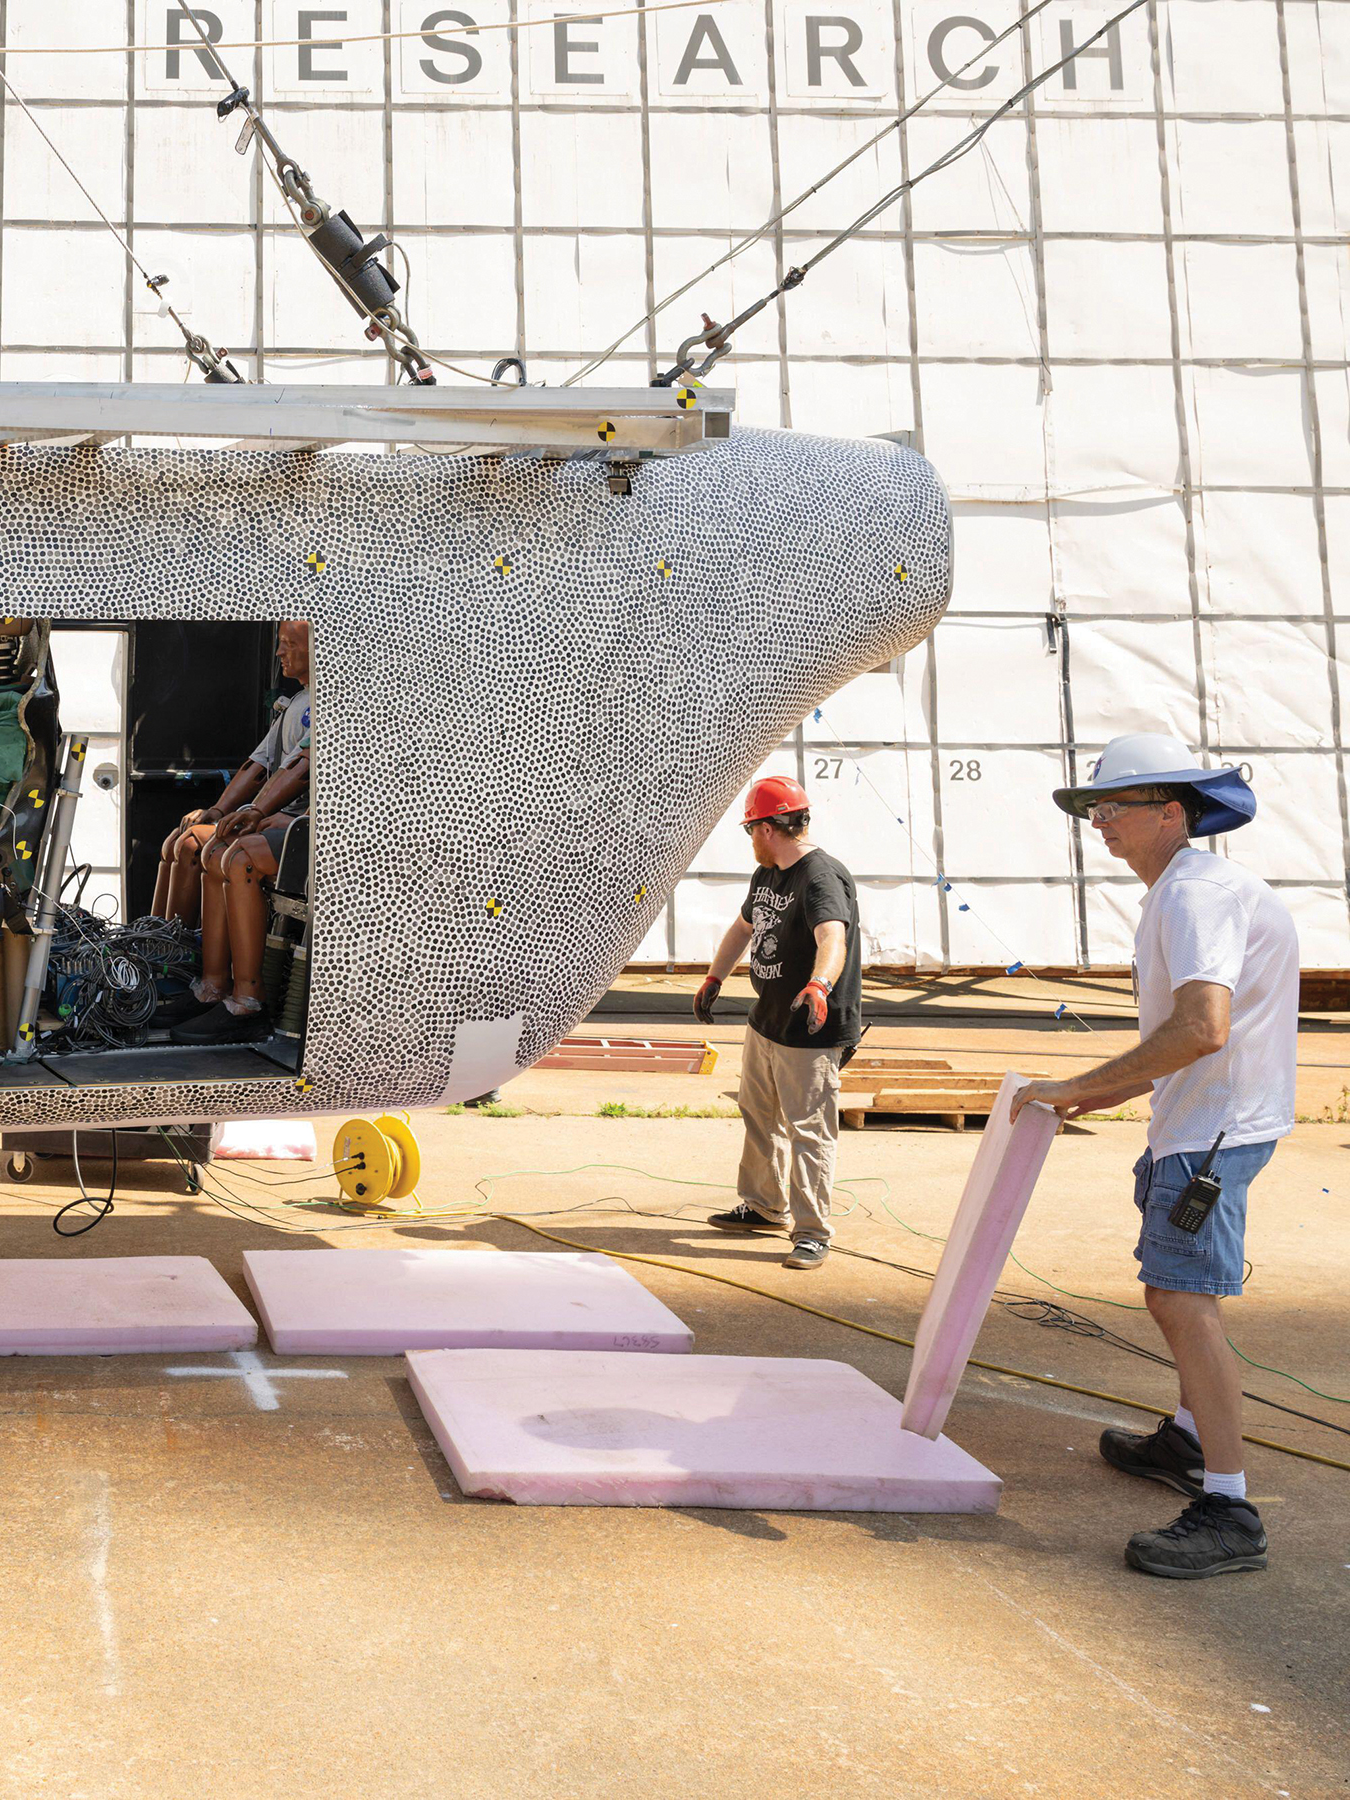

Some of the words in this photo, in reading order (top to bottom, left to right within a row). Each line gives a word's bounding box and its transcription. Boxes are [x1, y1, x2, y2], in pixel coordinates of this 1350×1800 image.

[165, 8, 1125, 92] RESEARCH
[814, 758, 844, 779] 27
[949, 759, 982, 781] 28
